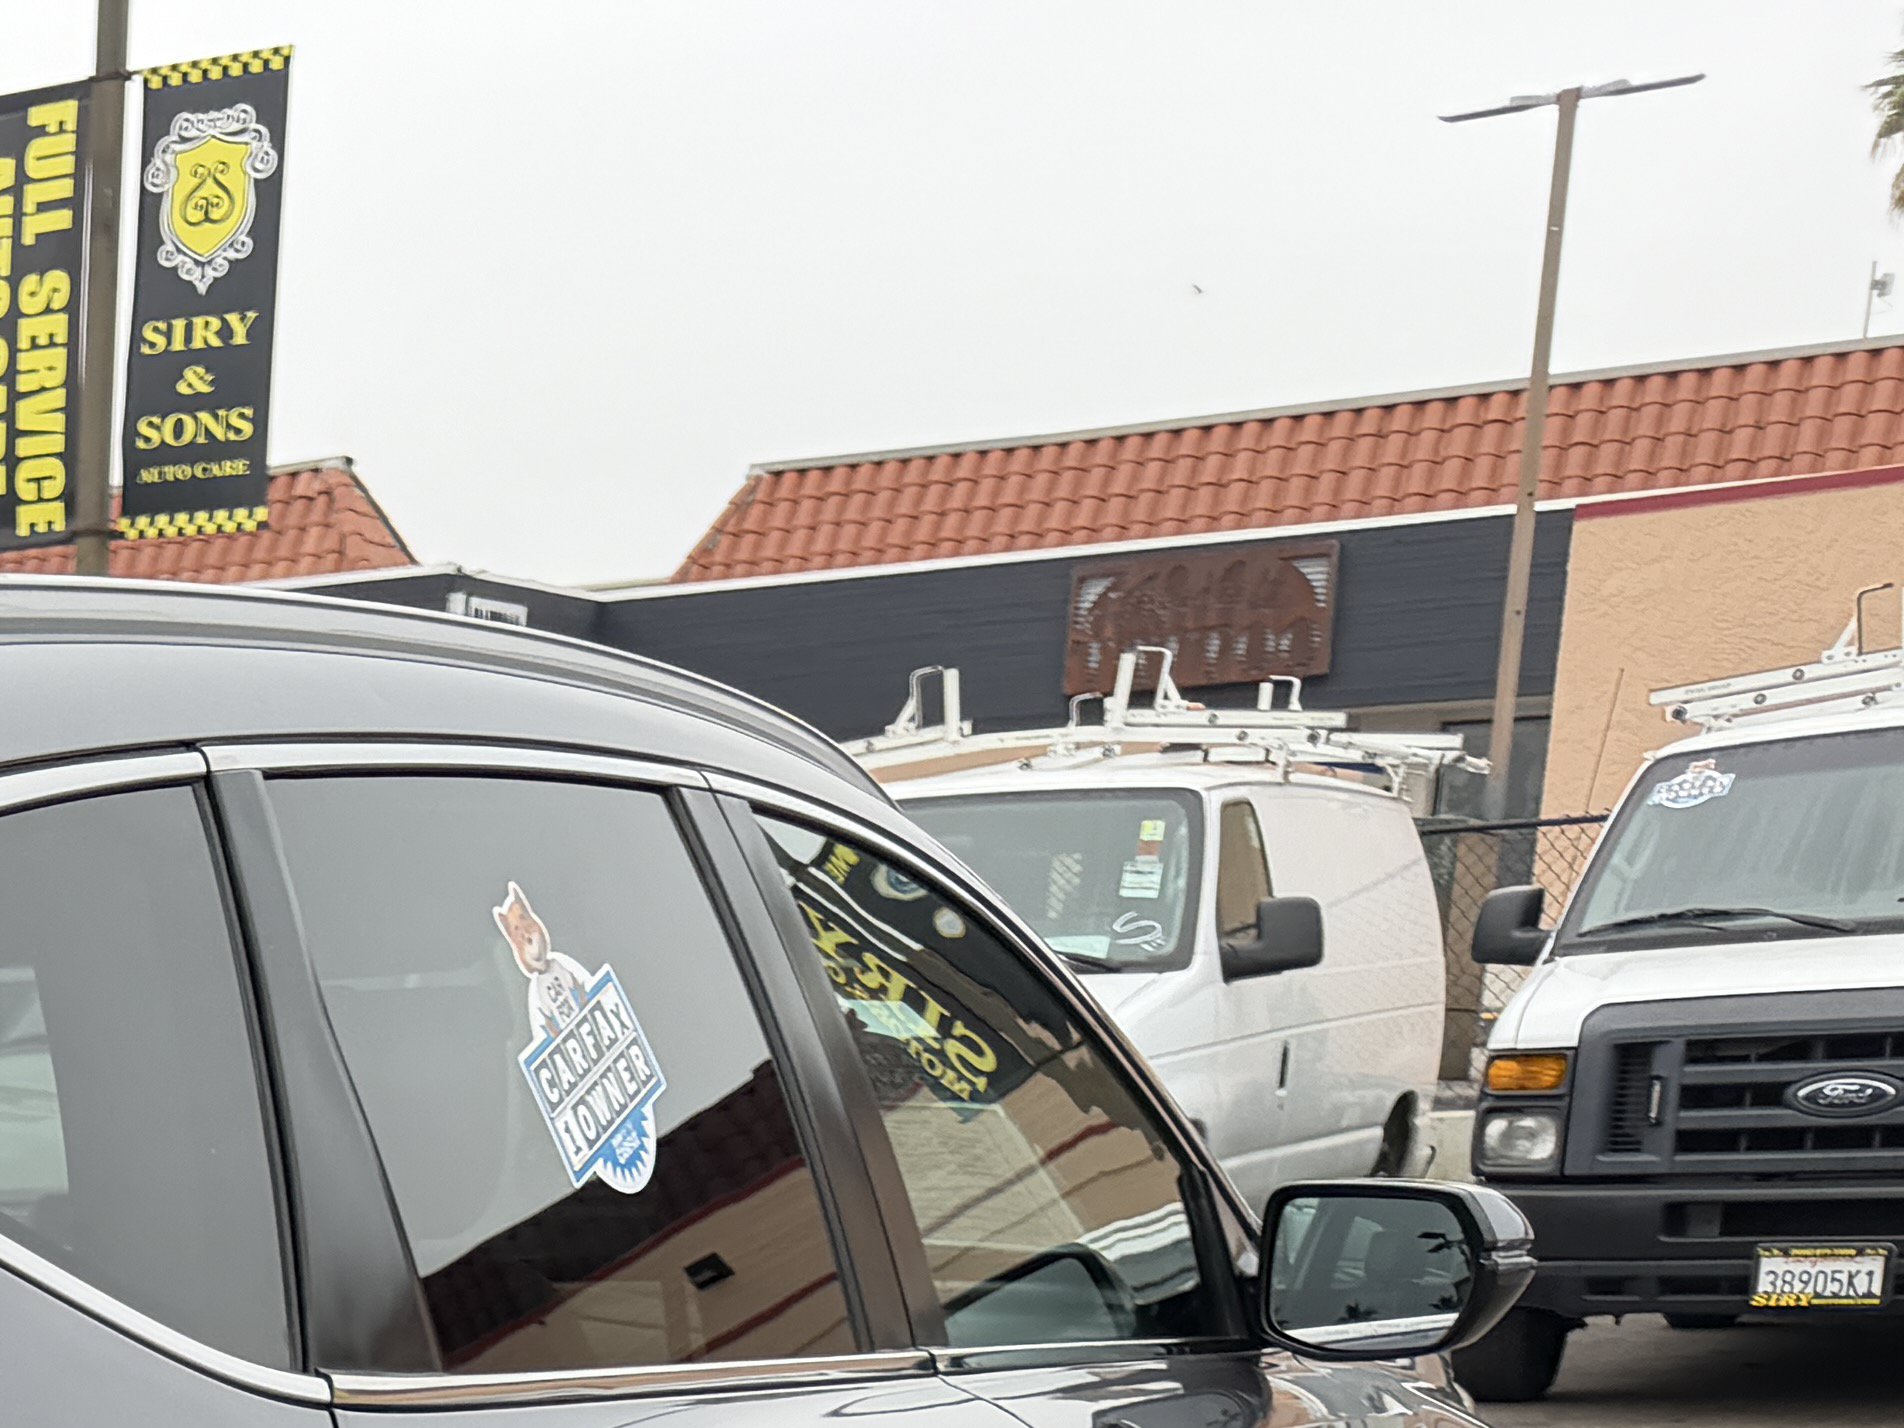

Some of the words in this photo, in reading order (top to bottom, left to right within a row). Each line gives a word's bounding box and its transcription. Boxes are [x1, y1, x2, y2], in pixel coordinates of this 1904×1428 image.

[21, 99, 80, 246] FULL
[139, 310, 259, 355] SIRY
[175, 365, 216, 395] &
[15, 270, 71, 537] SERVICE
[135, 406, 254, 450] SONS
[136, 463, 192, 485] AUTO
[193, 457, 251, 479] CARE
[539, 1002, 630, 1104] CARFAX
[1764, 1269, 1877, 1297] 38905K1
